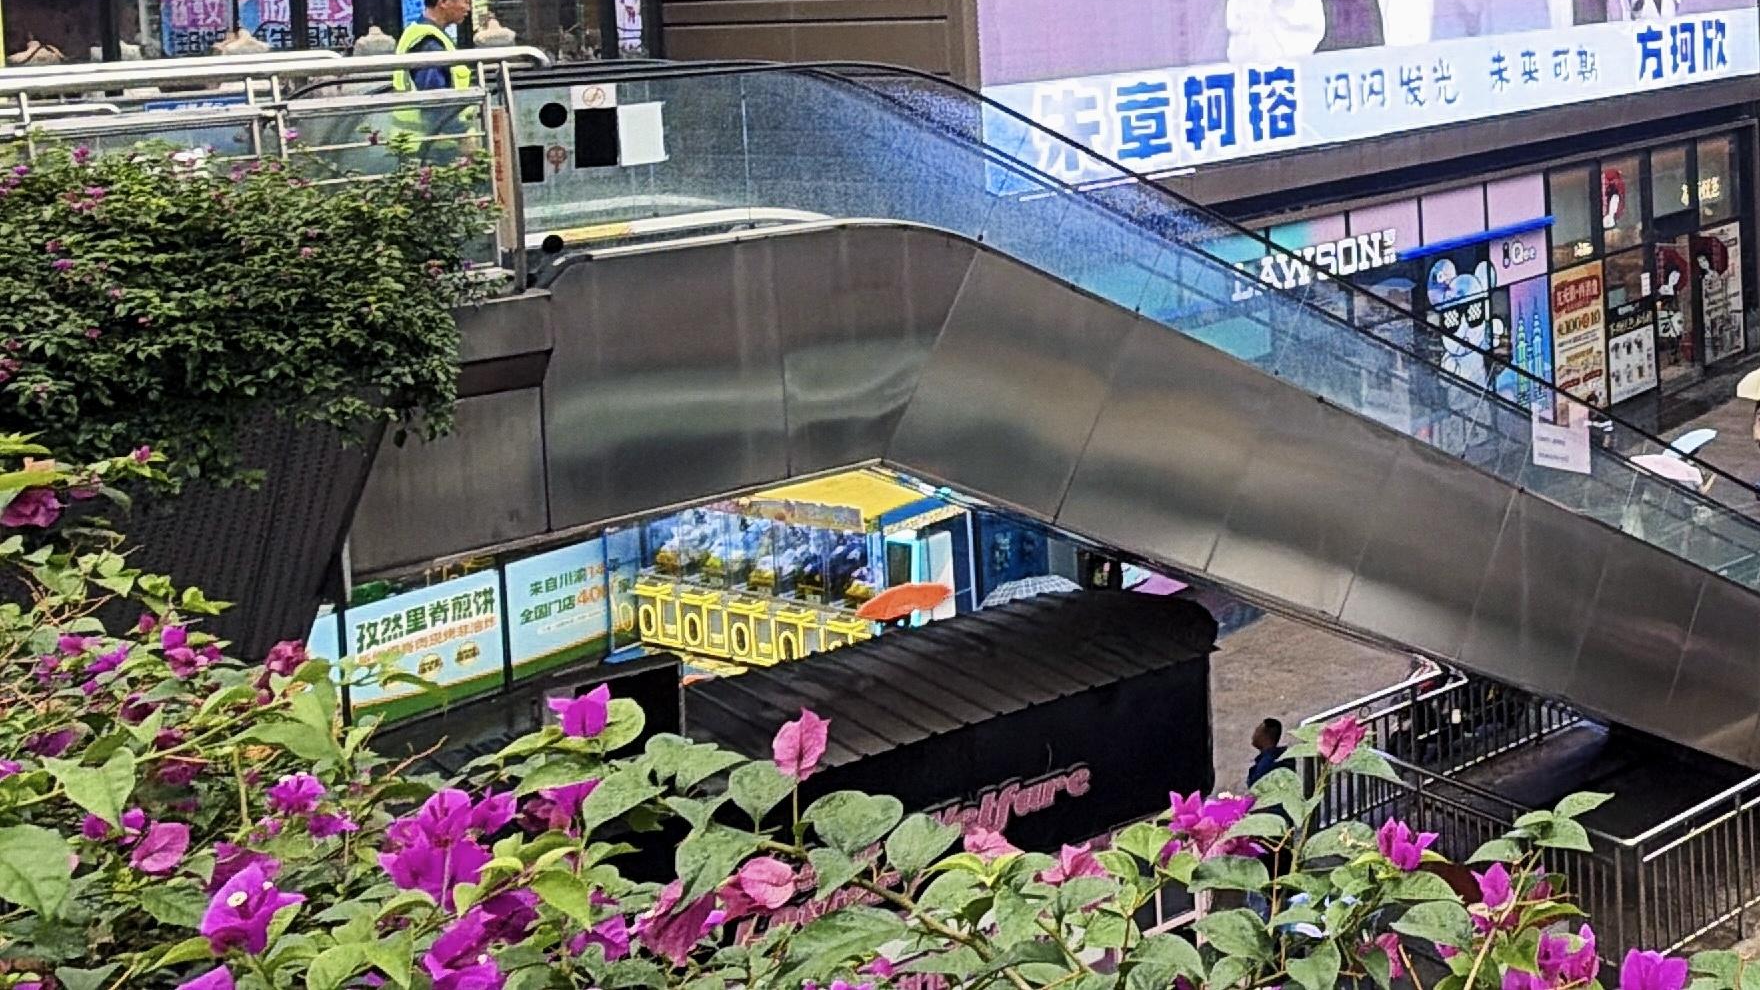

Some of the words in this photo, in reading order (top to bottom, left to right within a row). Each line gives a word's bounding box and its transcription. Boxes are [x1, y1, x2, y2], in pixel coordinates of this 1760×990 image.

[1323, 57, 1459, 114] 闪闪发光
[1636, 17, 1729, 80] 方珂欣
[355, 586, 496, 654] 孜然里脊煎饼
